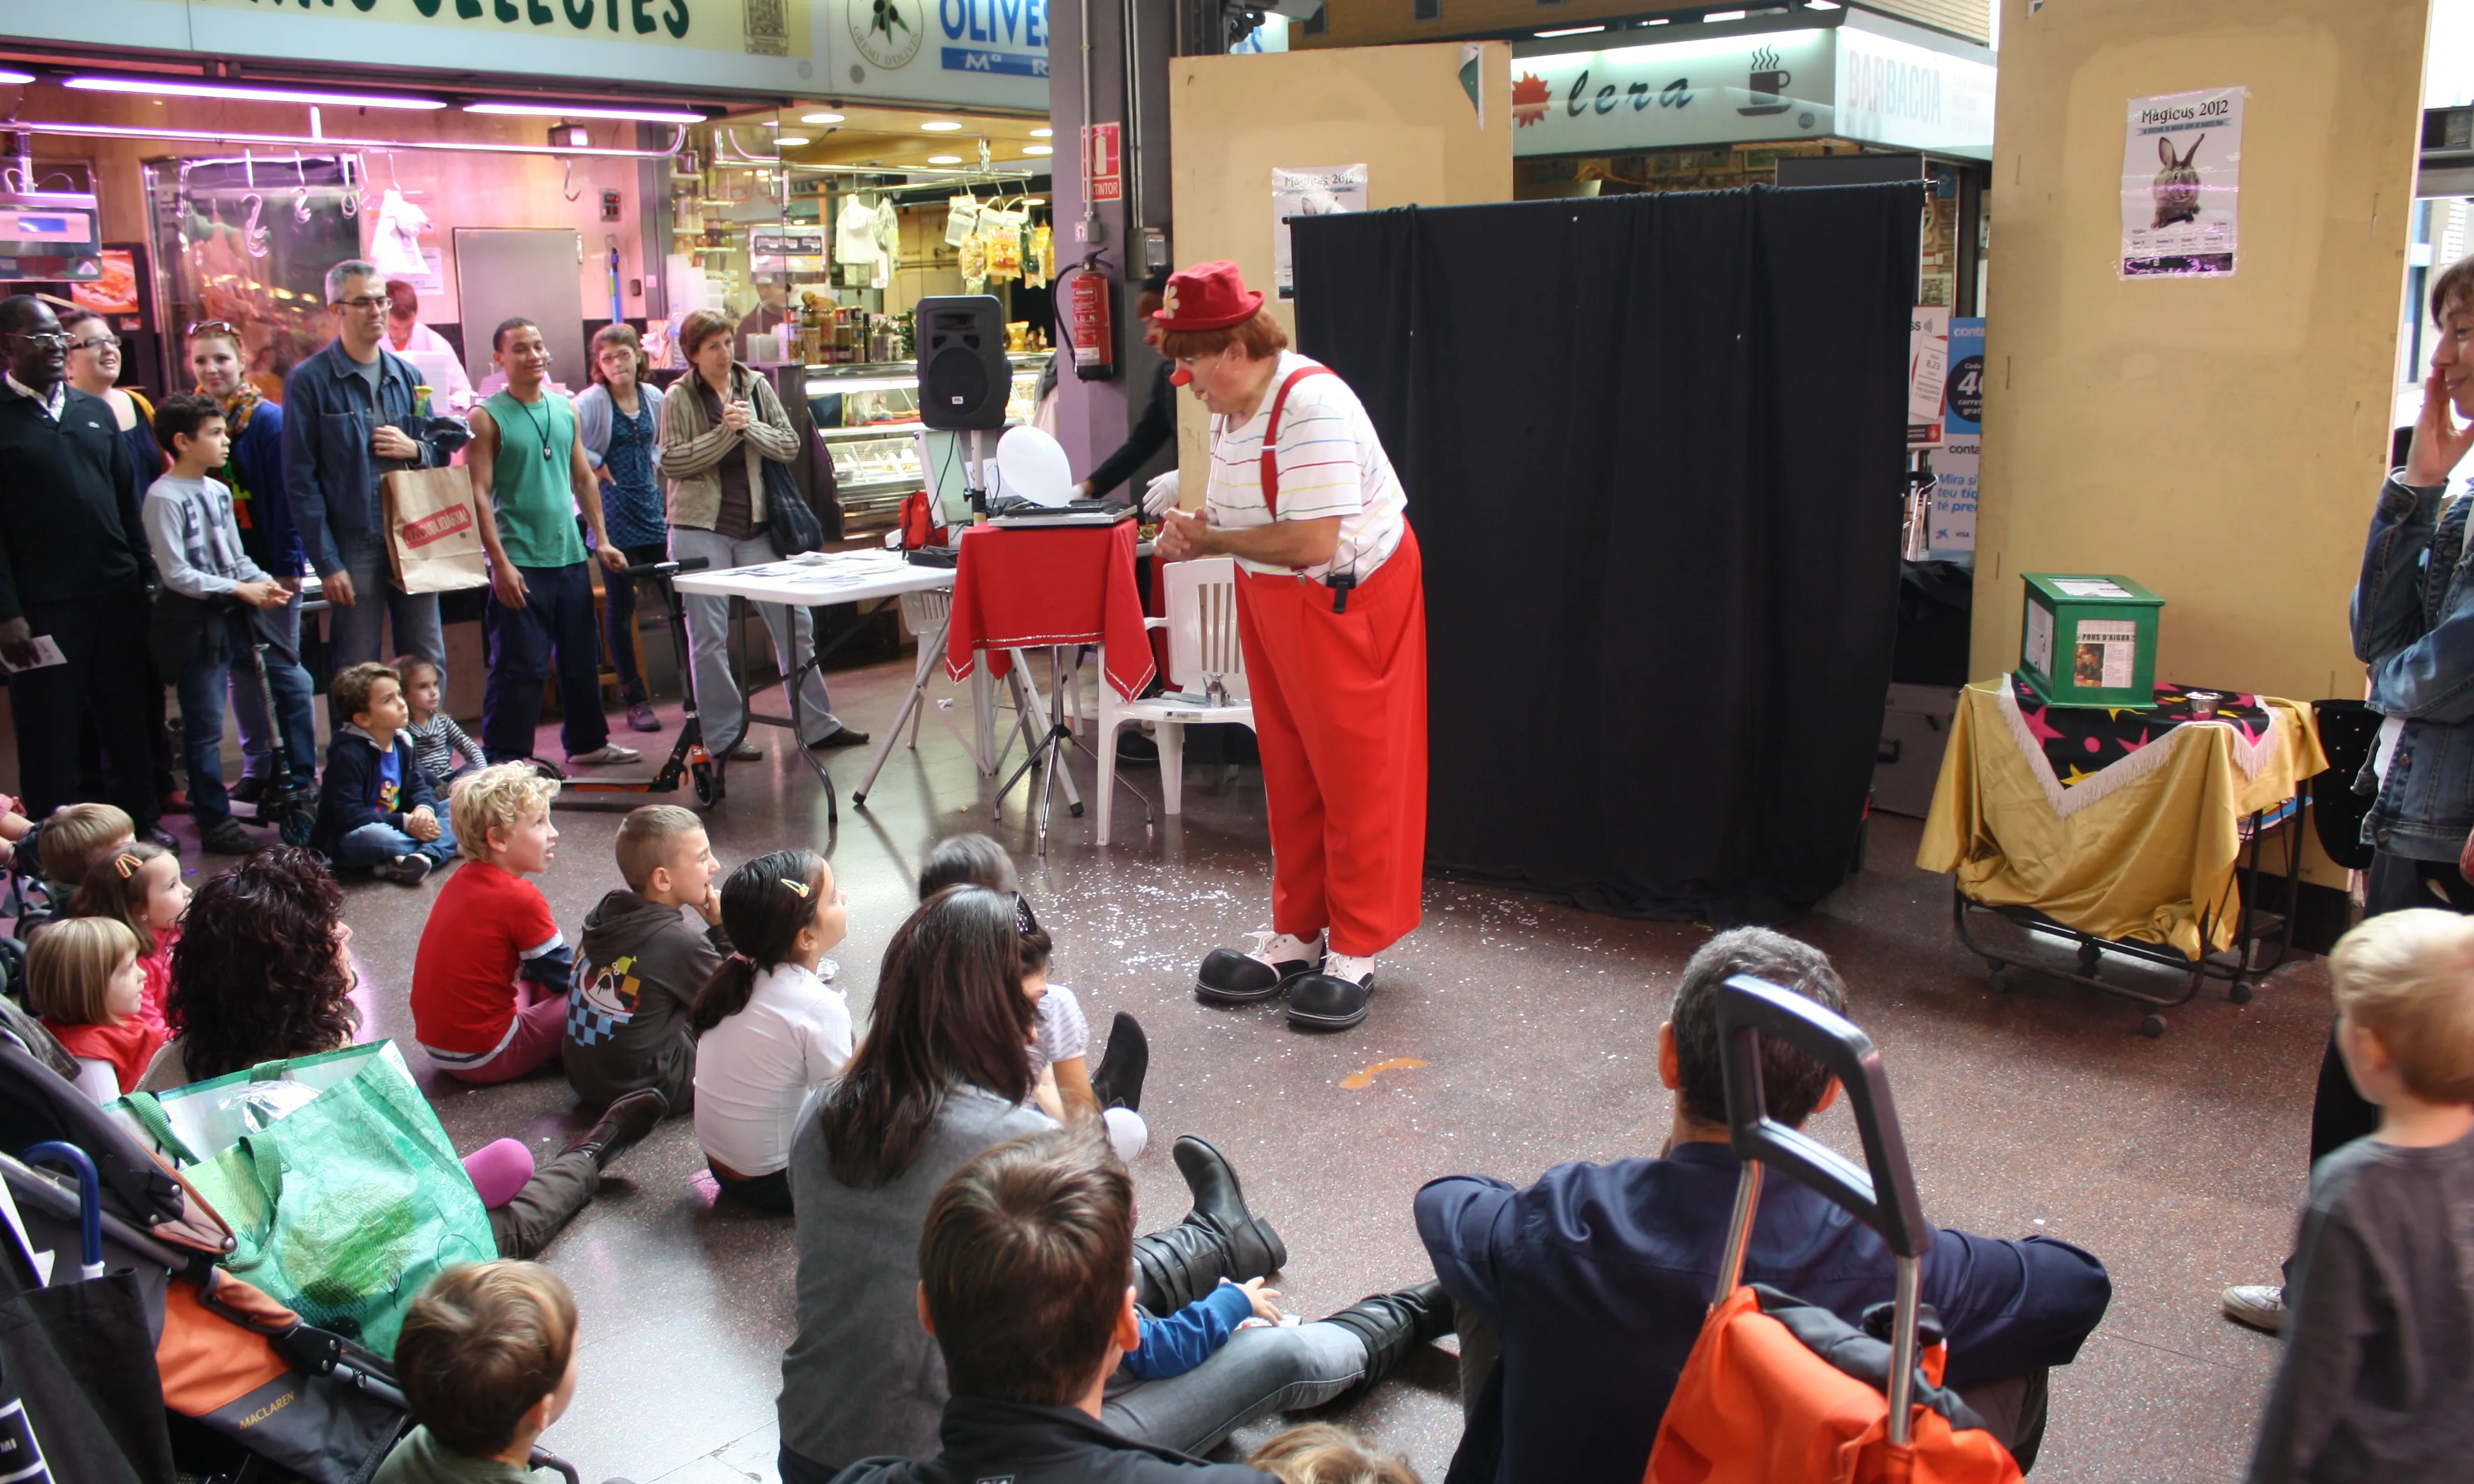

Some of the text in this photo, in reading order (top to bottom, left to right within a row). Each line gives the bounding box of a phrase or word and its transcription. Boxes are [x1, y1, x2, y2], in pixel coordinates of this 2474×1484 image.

[939, 0, 1049, 47] OLIVE
[1848, 49, 1941, 124] BARBACOA
[2141, 100, 2229, 124] Màgicus 2012
[1092, 182, 1118, 195] TINTOR
[1939, 474, 1965, 485] Mira
[1938, 488, 1957, 498] teu
[1937, 501, 1950, 510] té
[239, 1390, 295, 1430] MACLAREN
